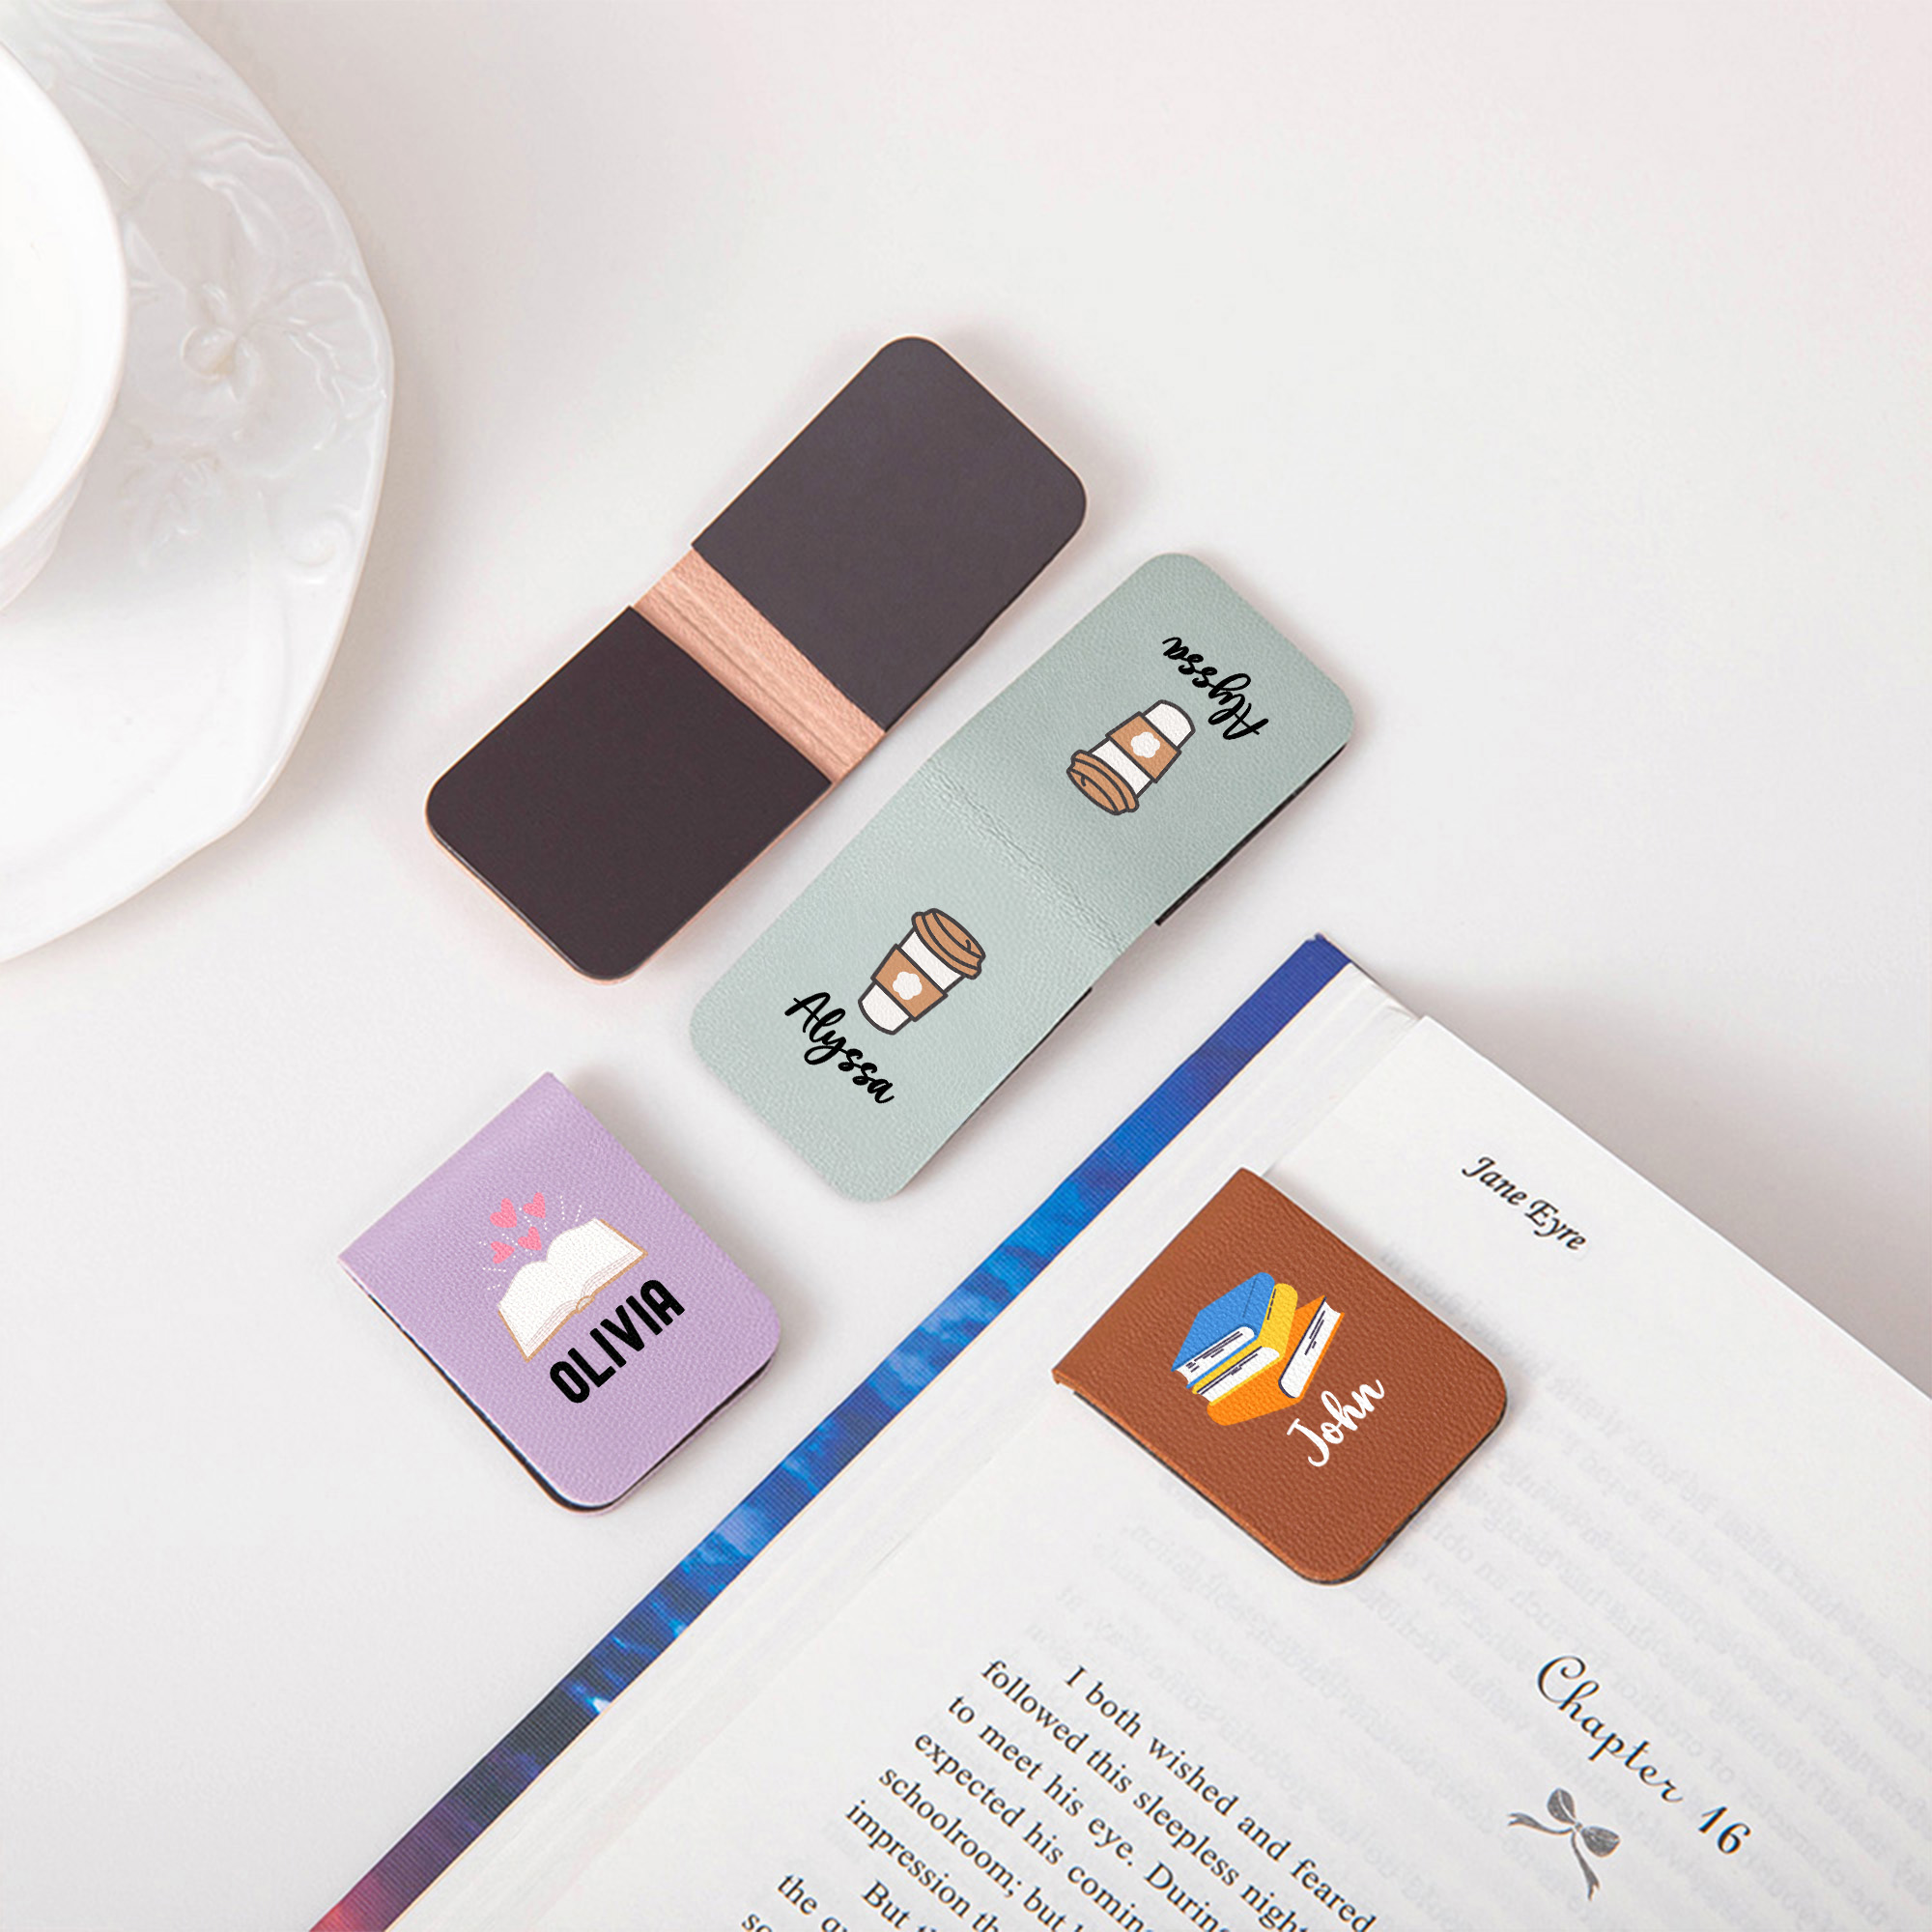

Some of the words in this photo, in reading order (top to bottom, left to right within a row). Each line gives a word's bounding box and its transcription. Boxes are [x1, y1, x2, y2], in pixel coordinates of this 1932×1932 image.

[1162, 637, 1268, 741] Alyssa
[784, 992, 894, 1103] Alyssa
[1462, 1157, 1527, 1206] Jane
[1526, 1195, 1586, 1250] Eyre
[550, 1280, 685, 1403] OLIVIA
[1287, 1379, 1385, 1467] John
[949, 1696, 975, 1723] to
[979, 1725, 1042, 1779] meet
[1043, 1775, 1084, 1816] his
[1089, 1818, 1133, 1866] eye.
[1144, 1861, 1230, 1932] Durin
[981, 1661, 1089, 1753] followed
[1087, 1749, 1132, 1793] this
[1133, 1793, 1239, 1886] sleepless
[1240, 1885, 1308, 1932] nigh
[1065, 1666, 1086, 1687] I
[1086, 1682, 1141, 1738] both
[1150, 1738, 1238, 1816] wished
[1237, 1817, 1292, 1861] and
[1291, 1859, 1377, 1932] feared
[1538, 1656, 1683, 1804] Chapter
[1698, 1805, 1751, 1854] 16
[846, 1800, 970, 1918] impression
[879, 1770, 1022, 1897] schoolroom;
[1023, 1887, 1065, 1932] but
[915, 1735, 1025, 1828] expected
[1023, 1822, 1064, 1864] his
[1067, 1866, 1152, 1932] comin
[778, 1875, 817, 1915] the
[863, 1880, 910, 1929] But
